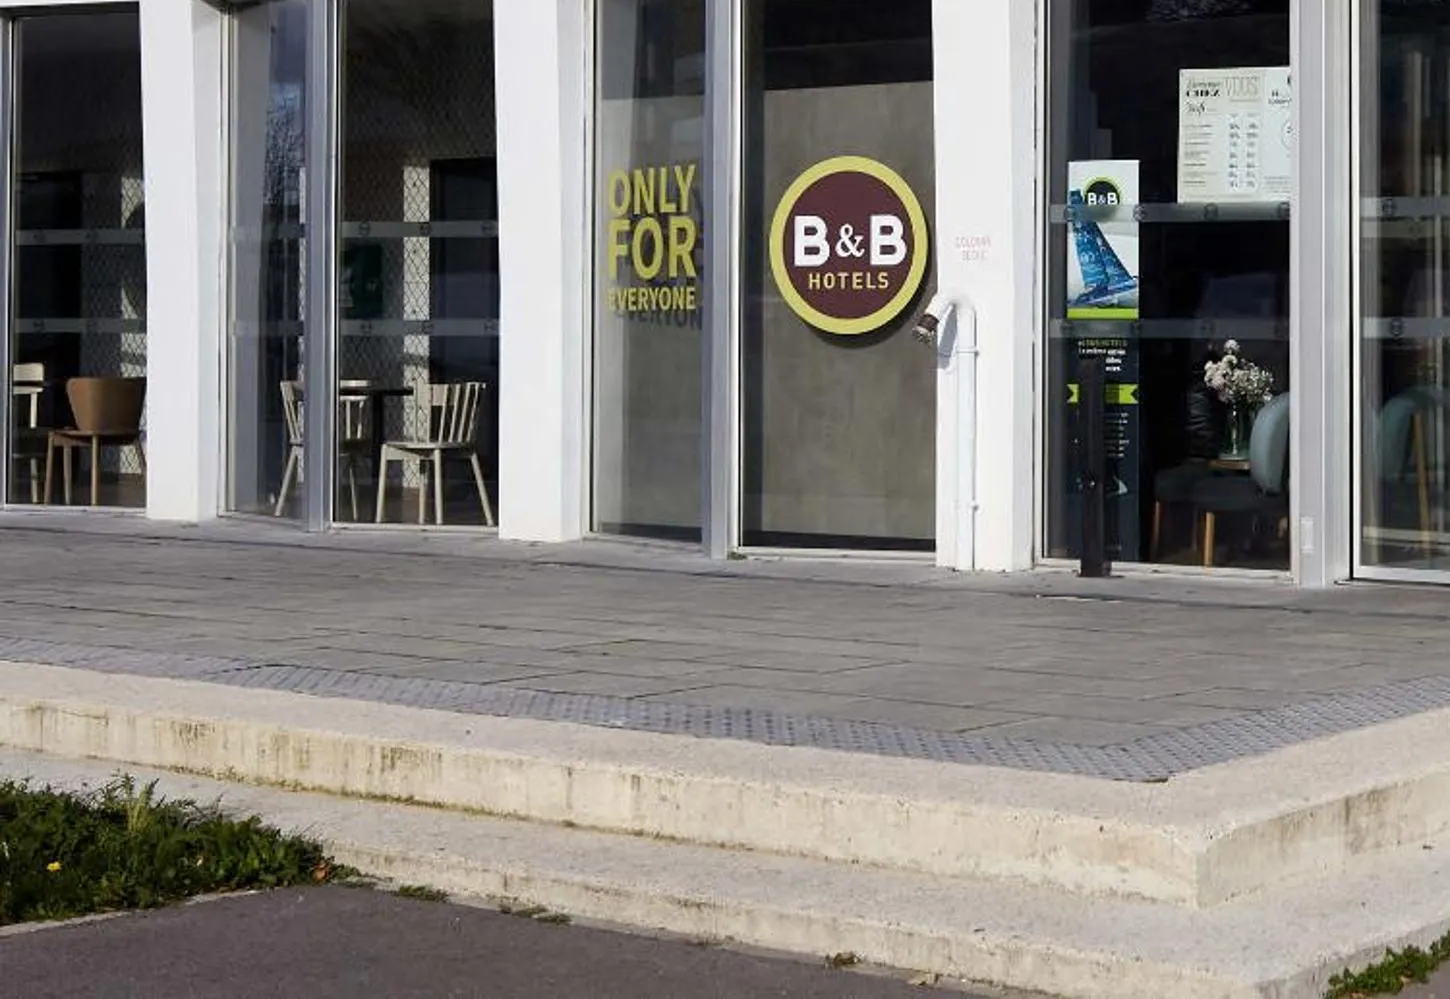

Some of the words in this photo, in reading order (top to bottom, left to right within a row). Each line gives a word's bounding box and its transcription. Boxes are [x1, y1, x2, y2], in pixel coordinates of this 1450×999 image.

[608, 164, 696, 217] ONLY
[1087, 192, 1119, 206] B&B
[607, 215, 697, 280] FOR
[793, 214, 908, 268] B&B
[607, 285, 697, 312] EVERYONE
[807, 271, 890, 290] HOTELS
